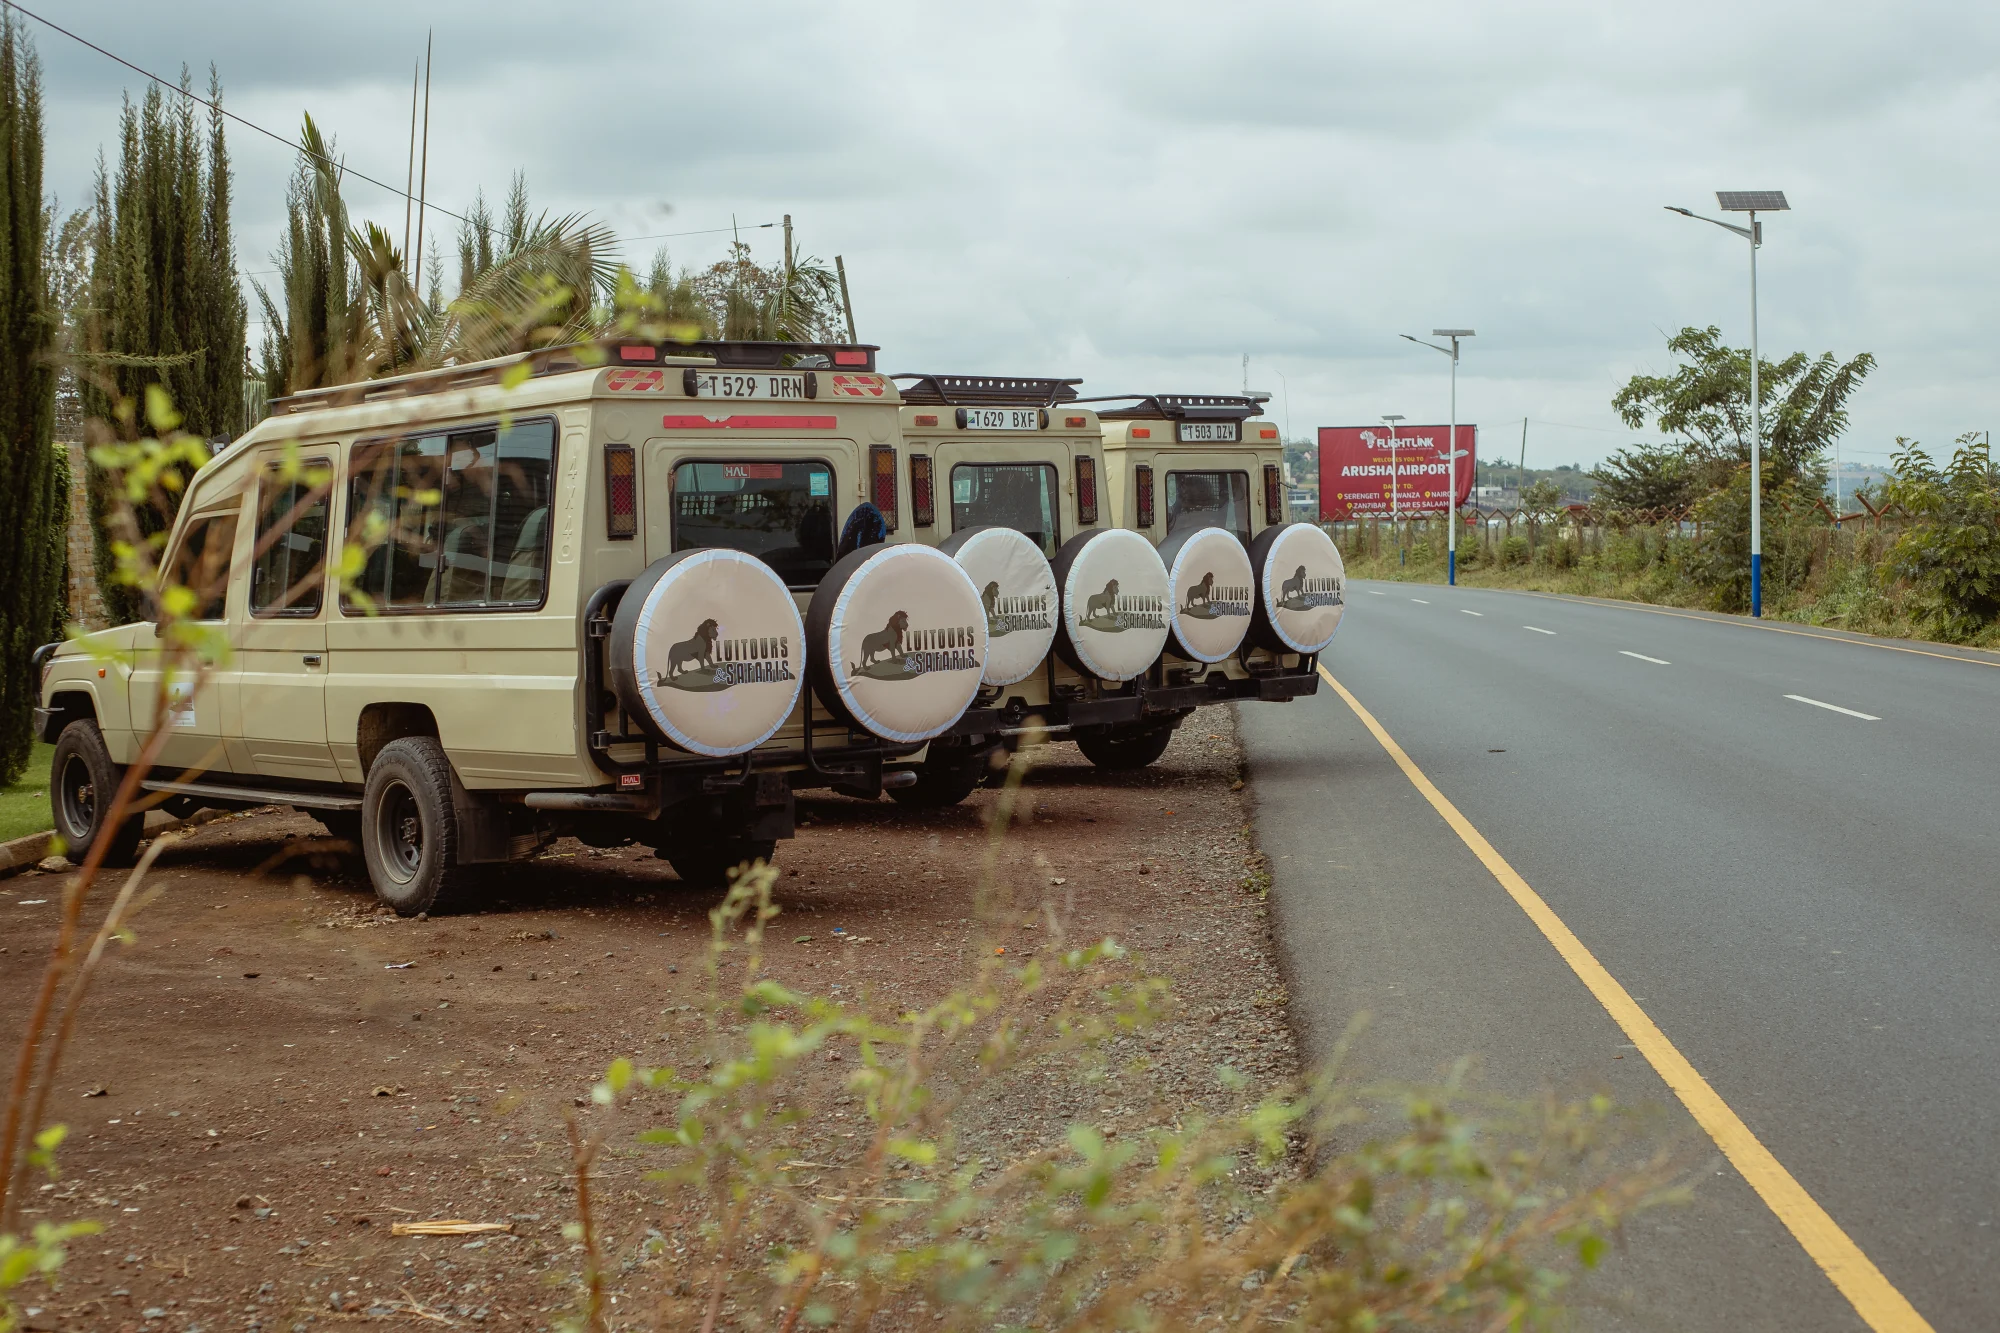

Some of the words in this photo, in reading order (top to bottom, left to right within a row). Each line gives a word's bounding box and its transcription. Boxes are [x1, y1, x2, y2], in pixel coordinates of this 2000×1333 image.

[710, 376, 718, 396] T
[723, 376, 757, 397] 529
[769, 377, 803, 398] DRN
[974, 411, 981, 426] T
[983, 411, 1004, 427] 629
[1012, 412, 1035, 428] BXF
[1187, 425, 1193, 439] T
[1195, 425, 1212, 439] 503
[1216, 425, 1234, 439] DZW
[725, 466, 748, 477] HAL
[1341, 465, 1393, 477] ARUSHA
[1397, 463, 1453, 476] AIRPORT
[1344, 492, 1380, 500] SERENGETI
[1431, 490, 1458, 498] NAIROI
[1422, 500, 1449, 508] SALAAM
[905, 625, 975, 651] LUITOURS
[715, 636, 788, 662] LUITOURS
